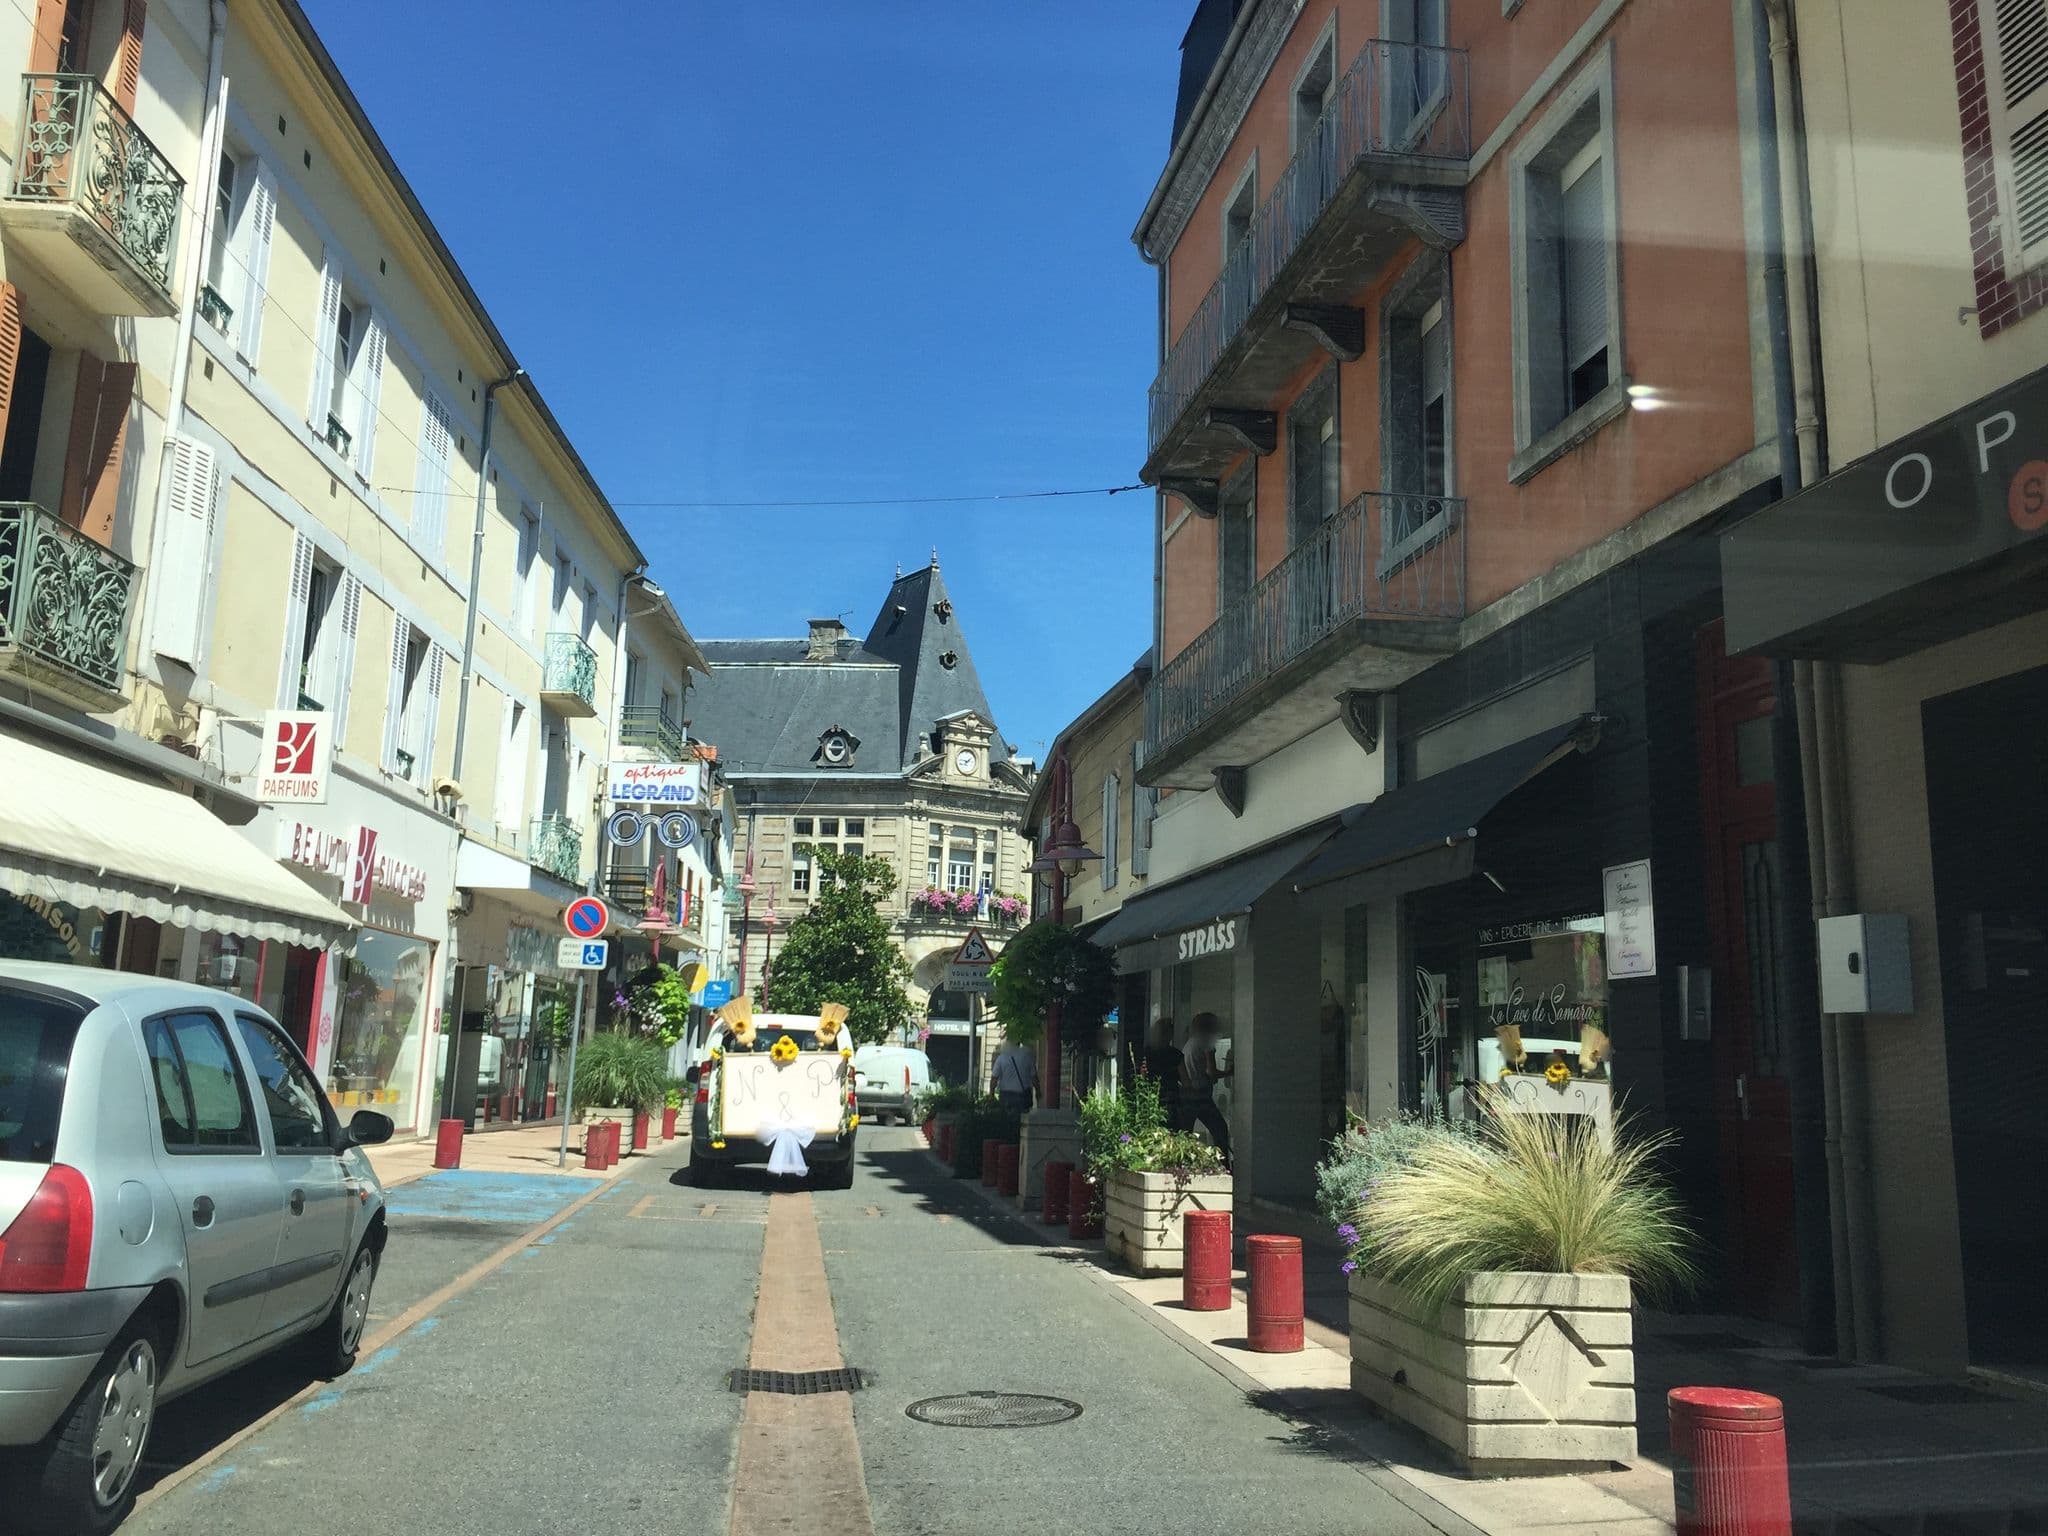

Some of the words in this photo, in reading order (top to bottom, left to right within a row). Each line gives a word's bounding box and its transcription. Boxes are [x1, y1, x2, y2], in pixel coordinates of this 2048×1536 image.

[263, 779, 319, 798] PARFUMS
[624, 765, 687, 784] optique
[611, 783, 695, 801] LEGRAND
[292, 822, 352, 876] BEAUTY
[378, 855, 426, 901] SUCCESS
[1178, 919, 1236, 960] STRASS
[1488, 994, 1505, 1025] La
[1506, 986, 1532, 1025] Cave
[1532, 991, 1547, 1022] de
[1548, 984, 1594, 1025] Samara
[934, 1023, 960, 1032] HOTEL
[733, 1064, 764, 1105] N
[807, 1059, 834, 1099] P
